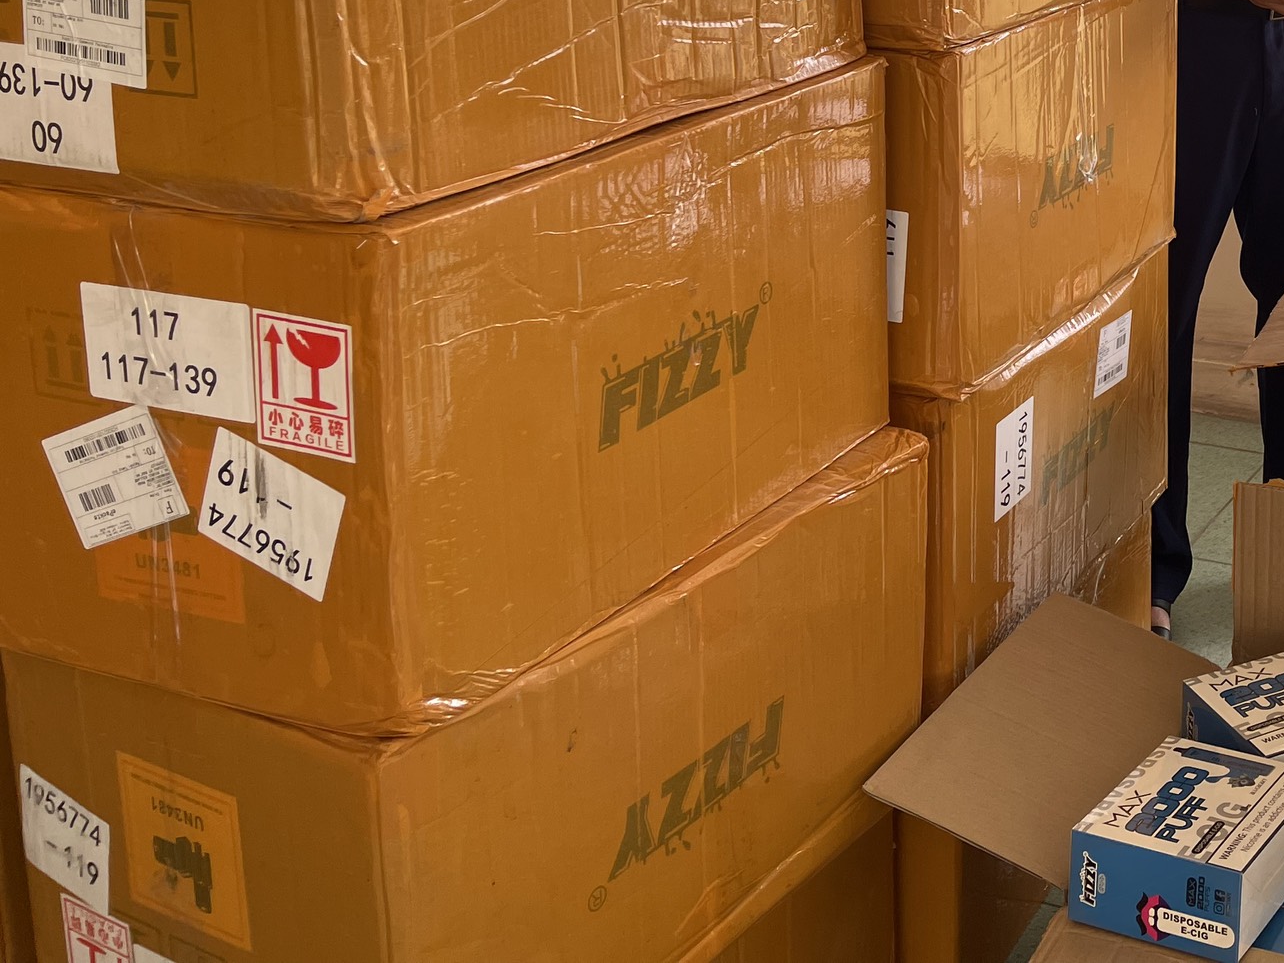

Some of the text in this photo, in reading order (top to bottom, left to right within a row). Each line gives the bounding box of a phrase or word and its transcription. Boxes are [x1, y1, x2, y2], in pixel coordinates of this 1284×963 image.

[32, 15, 45, 26] TO:
[31, 120, 63, 154] 60
[131, 307, 180, 341] 117
[101, 350, 218, 397] 117-139
[268, 408, 346, 438] 小心易碎
[268, 427, 345, 452] FRAGILE
[1016, 411, 1028, 496] 1956774
[208, 502, 314, 583] 1956774
[1208, 667, 1274, 692] MAX
[606, 695, 784, 883] FIZZY
[1124, 766, 1210, 837] 2000
[24, 777, 102, 847] 1956774
[1103, 790, 1152, 828] MAX
[1154, 795, 1208, 844] PUFF
[1218, 831, 1248, 860] WARNING:
[1242, 822, 1256, 834] This
[1252, 808, 1269, 825] product
[1240, 831, 1263, 853] Nicotine
[1262, 819, 1272, 830] an
[1082, 852, 1097, 907] FIZZY
[1188, 878, 1197, 907] MAX
[1197, 877, 1206, 910] 2000
[1163, 911, 1228, 936] DISPOSABLE
[1180, 927, 1209, 941] E-CIG
